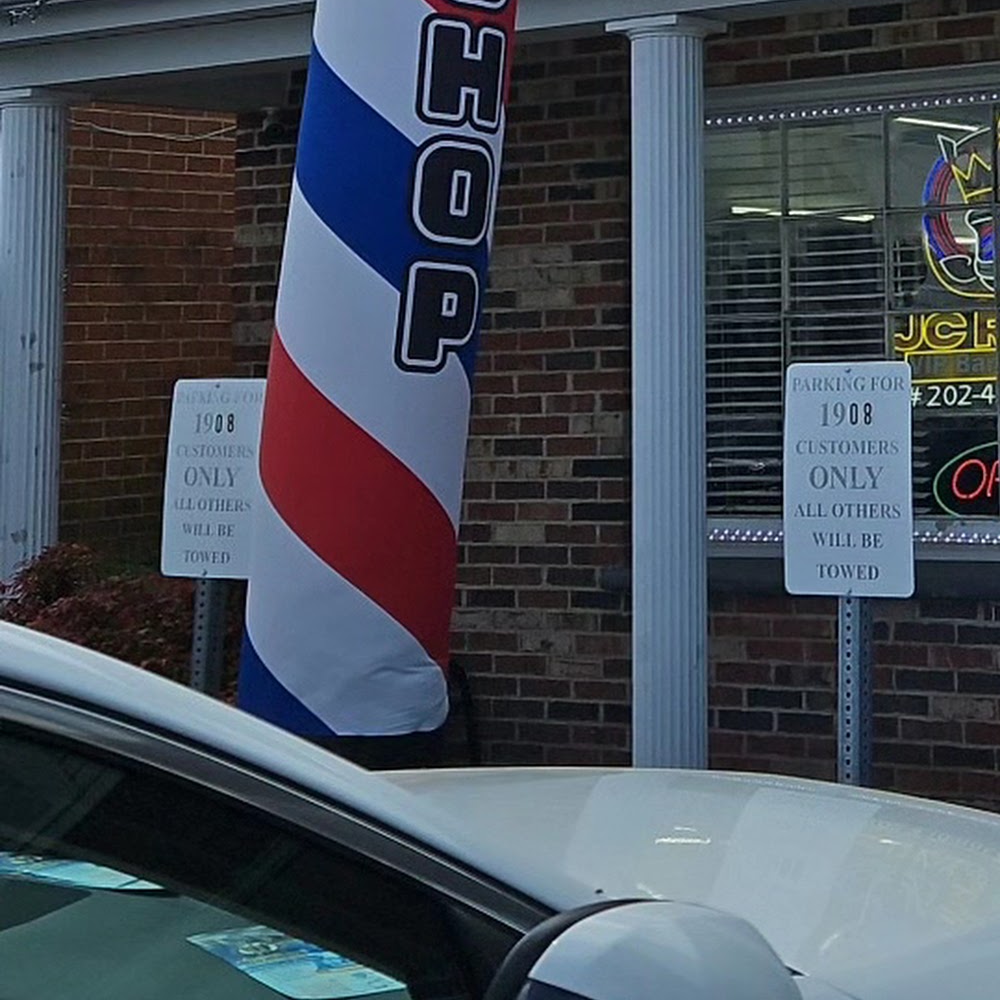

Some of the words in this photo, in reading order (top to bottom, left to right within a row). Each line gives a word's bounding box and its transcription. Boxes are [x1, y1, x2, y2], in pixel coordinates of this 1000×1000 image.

[894, 311, 968, 351] JC
[792, 376, 866, 393] PARKING
[871, 375, 905, 392] FOR
[195, 412, 235, 434] 1908
[821, 402, 872, 427] 1908
[176, 444, 254, 459] CUSTOMERS
[796, 439, 900, 456] CUSTOMERS
[184, 466, 240, 488] ONLY
[809, 465, 884, 490] ONLY
[197, 498, 252, 512] OTHERS
[794, 503, 827, 518] ALL
[832, 503, 901, 519] OTHERS
[182, 522, 216, 537] WILL
[217, 523, 236, 538] BE
[812, 532, 857, 548] WILL
[862, 533, 884, 549] BE
[184, 549, 231, 564] TOWED
[816, 563, 880, 581] TOWED
